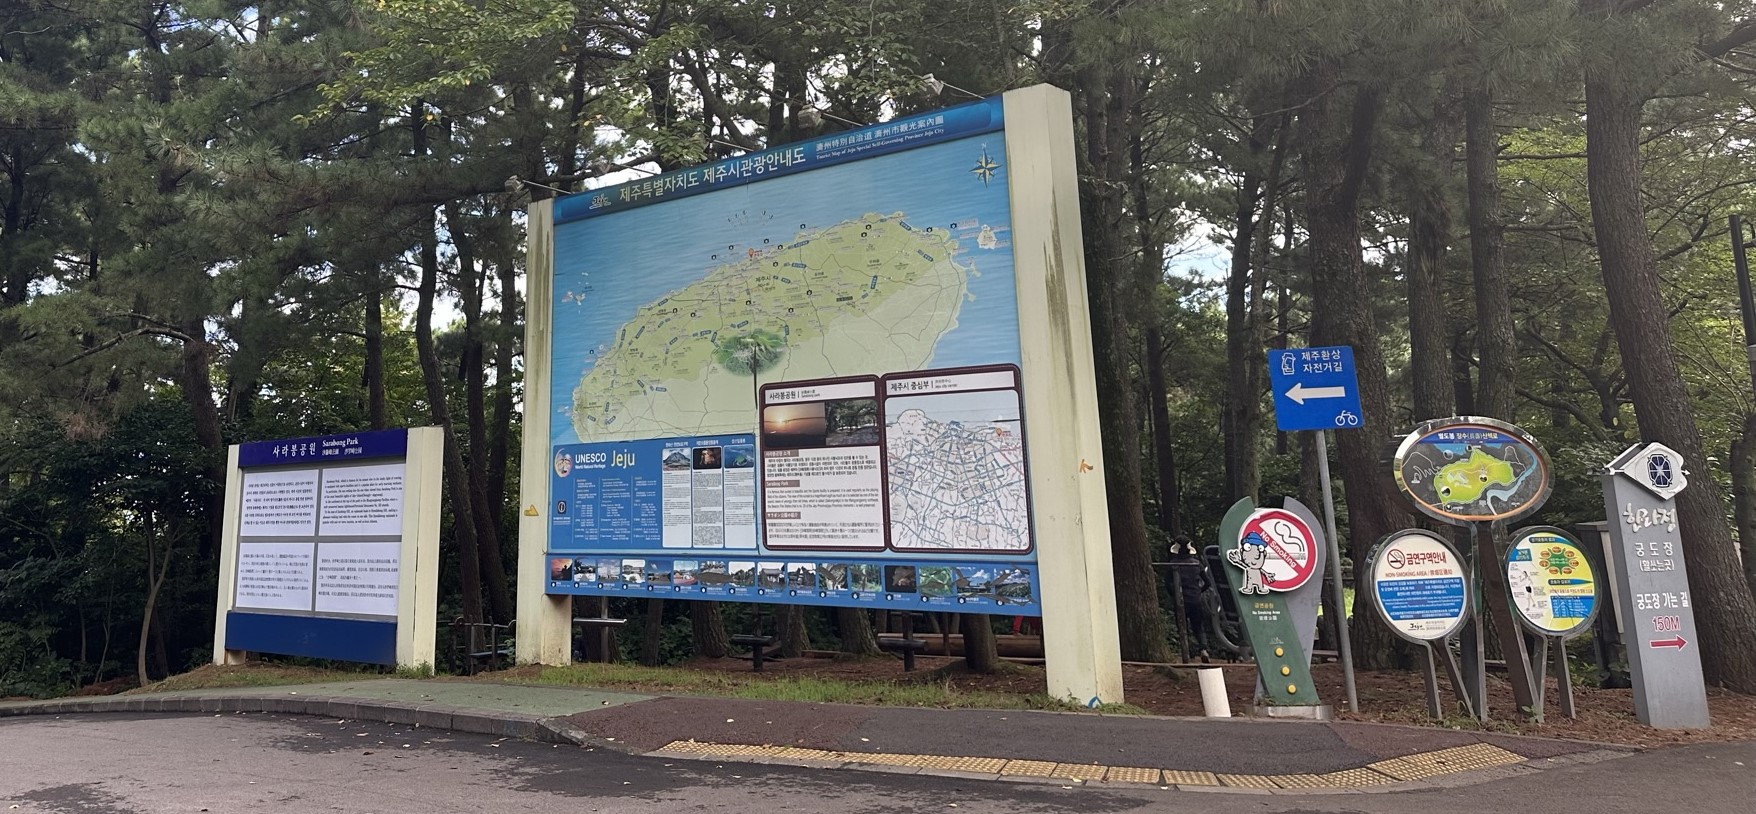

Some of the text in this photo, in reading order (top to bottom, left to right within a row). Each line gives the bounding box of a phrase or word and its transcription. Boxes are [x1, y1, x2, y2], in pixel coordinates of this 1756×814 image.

[856, 143, 872, 152] Special
[619, 171, 700, 203] 제주특별자치도
[703, 147, 806, 185] 제주시관광안내도
[1301, 349, 1341, 361] 제주환상
[1303, 362, 1343, 374] 자전거길
[891, 382, 910, 391] 제주시
[910, 380, 930, 390] 중심부
[769, 390, 796, 400] 사라봉공원
[322, 437, 359, 447] Sarabong Park
[273, 442, 316, 458] 사라봉공원
[575, 448, 635, 469] UNESCO Jeju
[1260, 531, 1297, 569] No Smoking
[1406, 551, 1447, 566] 금연구역안내
[1636, 591, 1689, 610] 궁도장 가는 길
[1652, 616, 1681, 631] 150M
